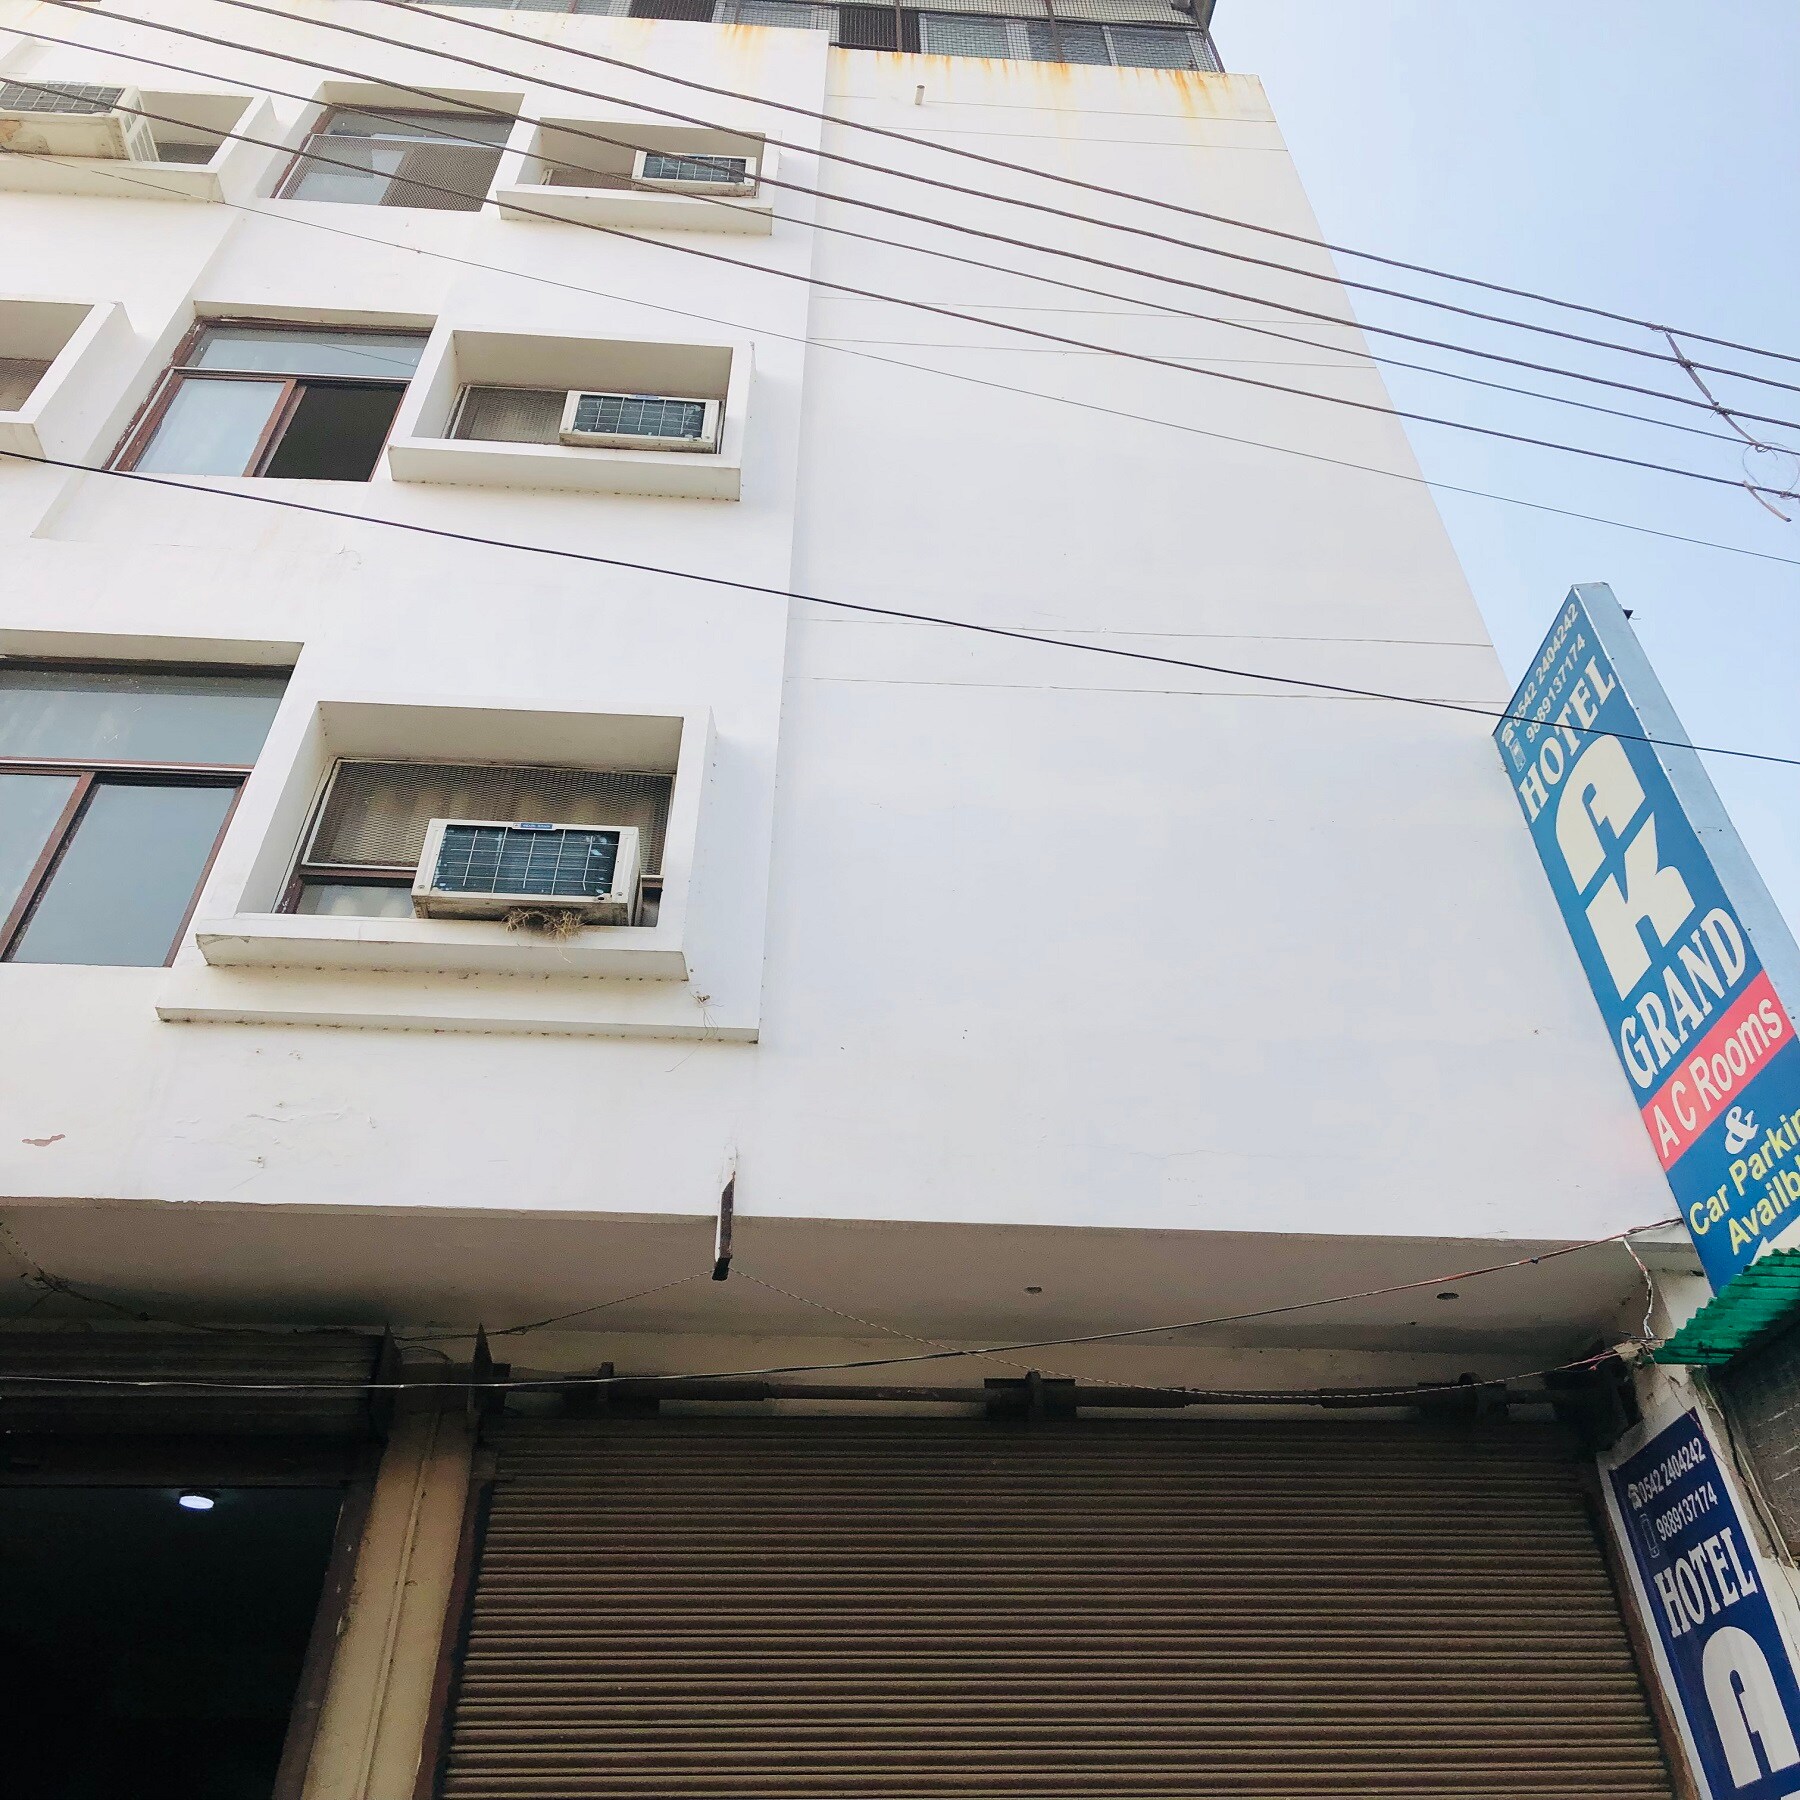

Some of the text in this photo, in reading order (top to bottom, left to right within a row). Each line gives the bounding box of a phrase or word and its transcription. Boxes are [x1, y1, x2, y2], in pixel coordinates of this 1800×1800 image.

[1512, 603, 1579, 727] 0542 2404242
[1526, 633, 1586, 744] 9889137174
[1518, 655, 1616, 823] HOTEL
[1620, 908, 1746, 1089] GRAND
[1653, 998, 1783, 1159] A C Rooms
[1724, 1106, 1760, 1154] &
[1689, 1183, 1730, 1235] Car
[1728, 1154, 1800, 1256] Availb
[1638, 1437, 1707, 1501] 0542 2404242
[1655, 1480, 1719, 1542] 9889137174
[1654, 1526, 1759, 1639] HOTEL
